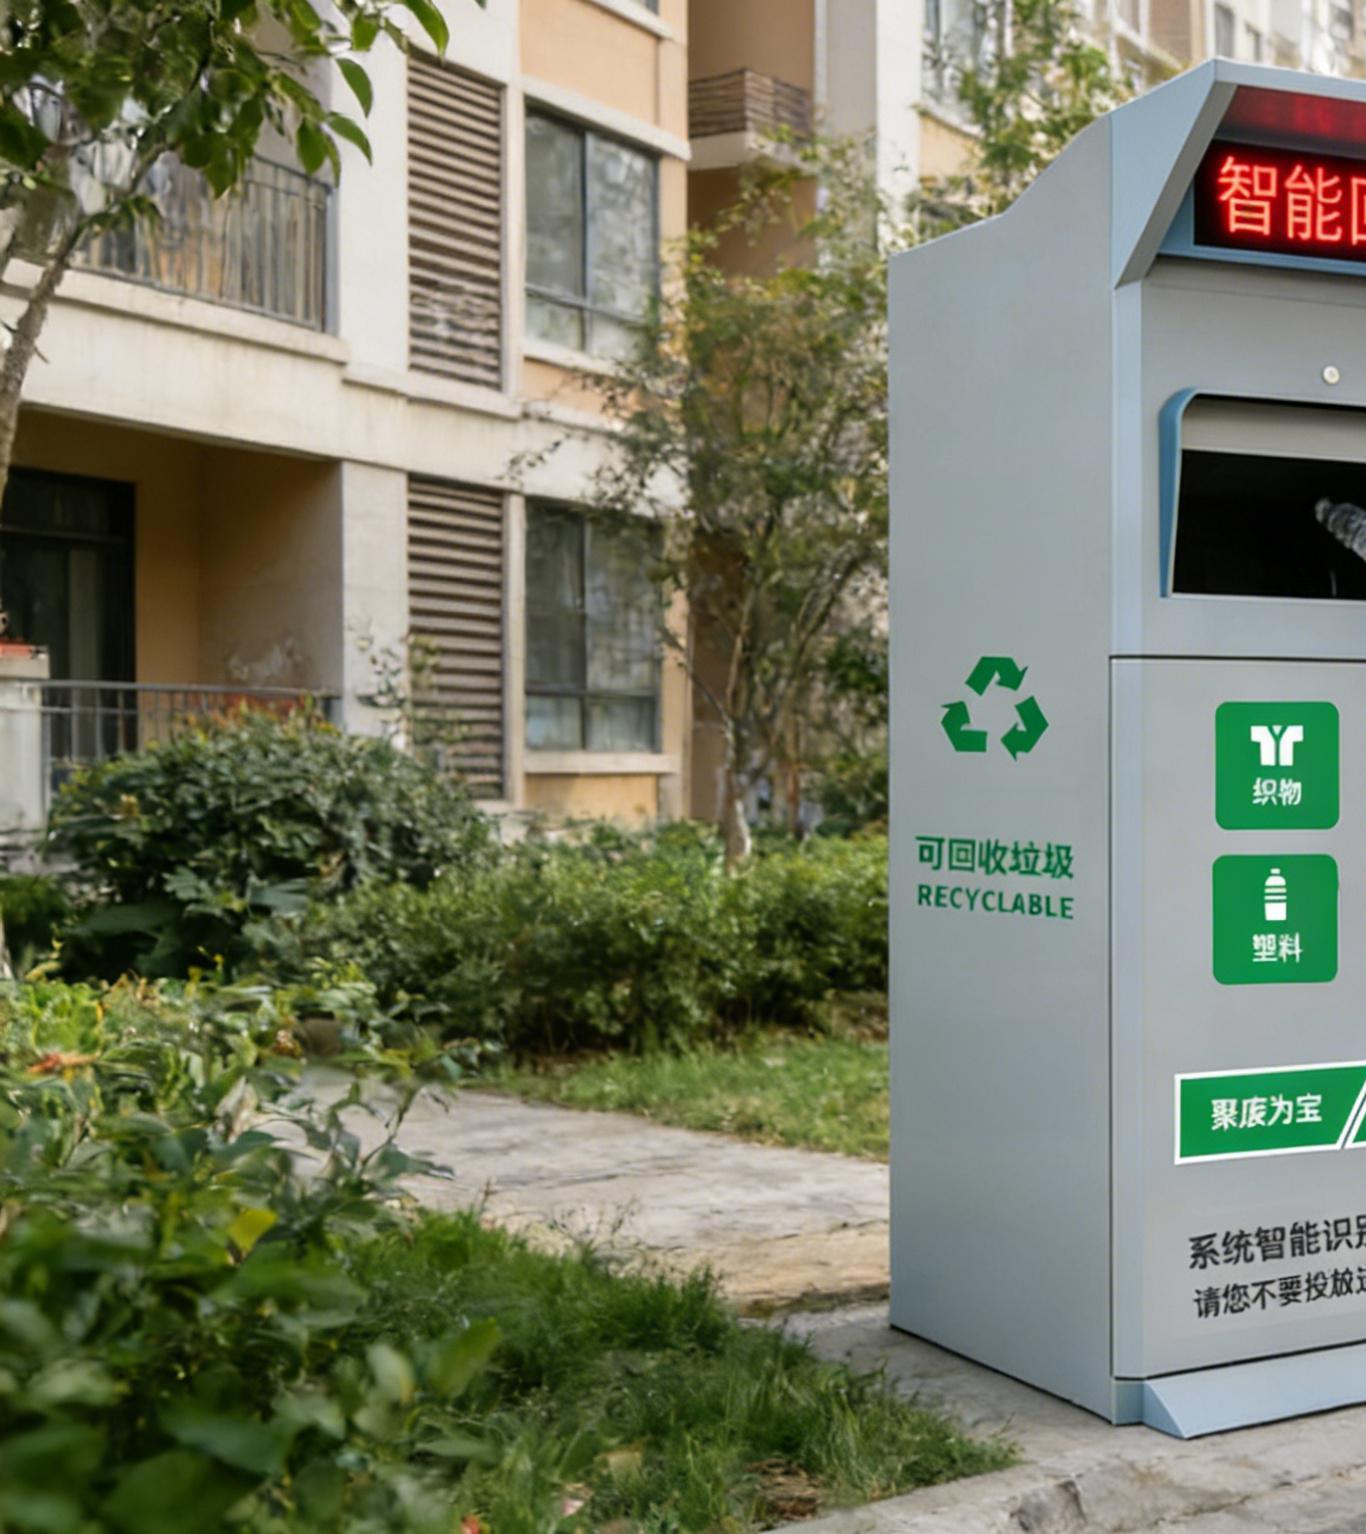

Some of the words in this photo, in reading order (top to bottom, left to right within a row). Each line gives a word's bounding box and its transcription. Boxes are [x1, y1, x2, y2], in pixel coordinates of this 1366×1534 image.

[1252, 777, 1302, 806] 织物
[915, 835, 1074, 879] 可回收垃圾
[917, 884, 1074, 920] RECYCLABLE
[1252, 932, 1303, 963] 塑料
